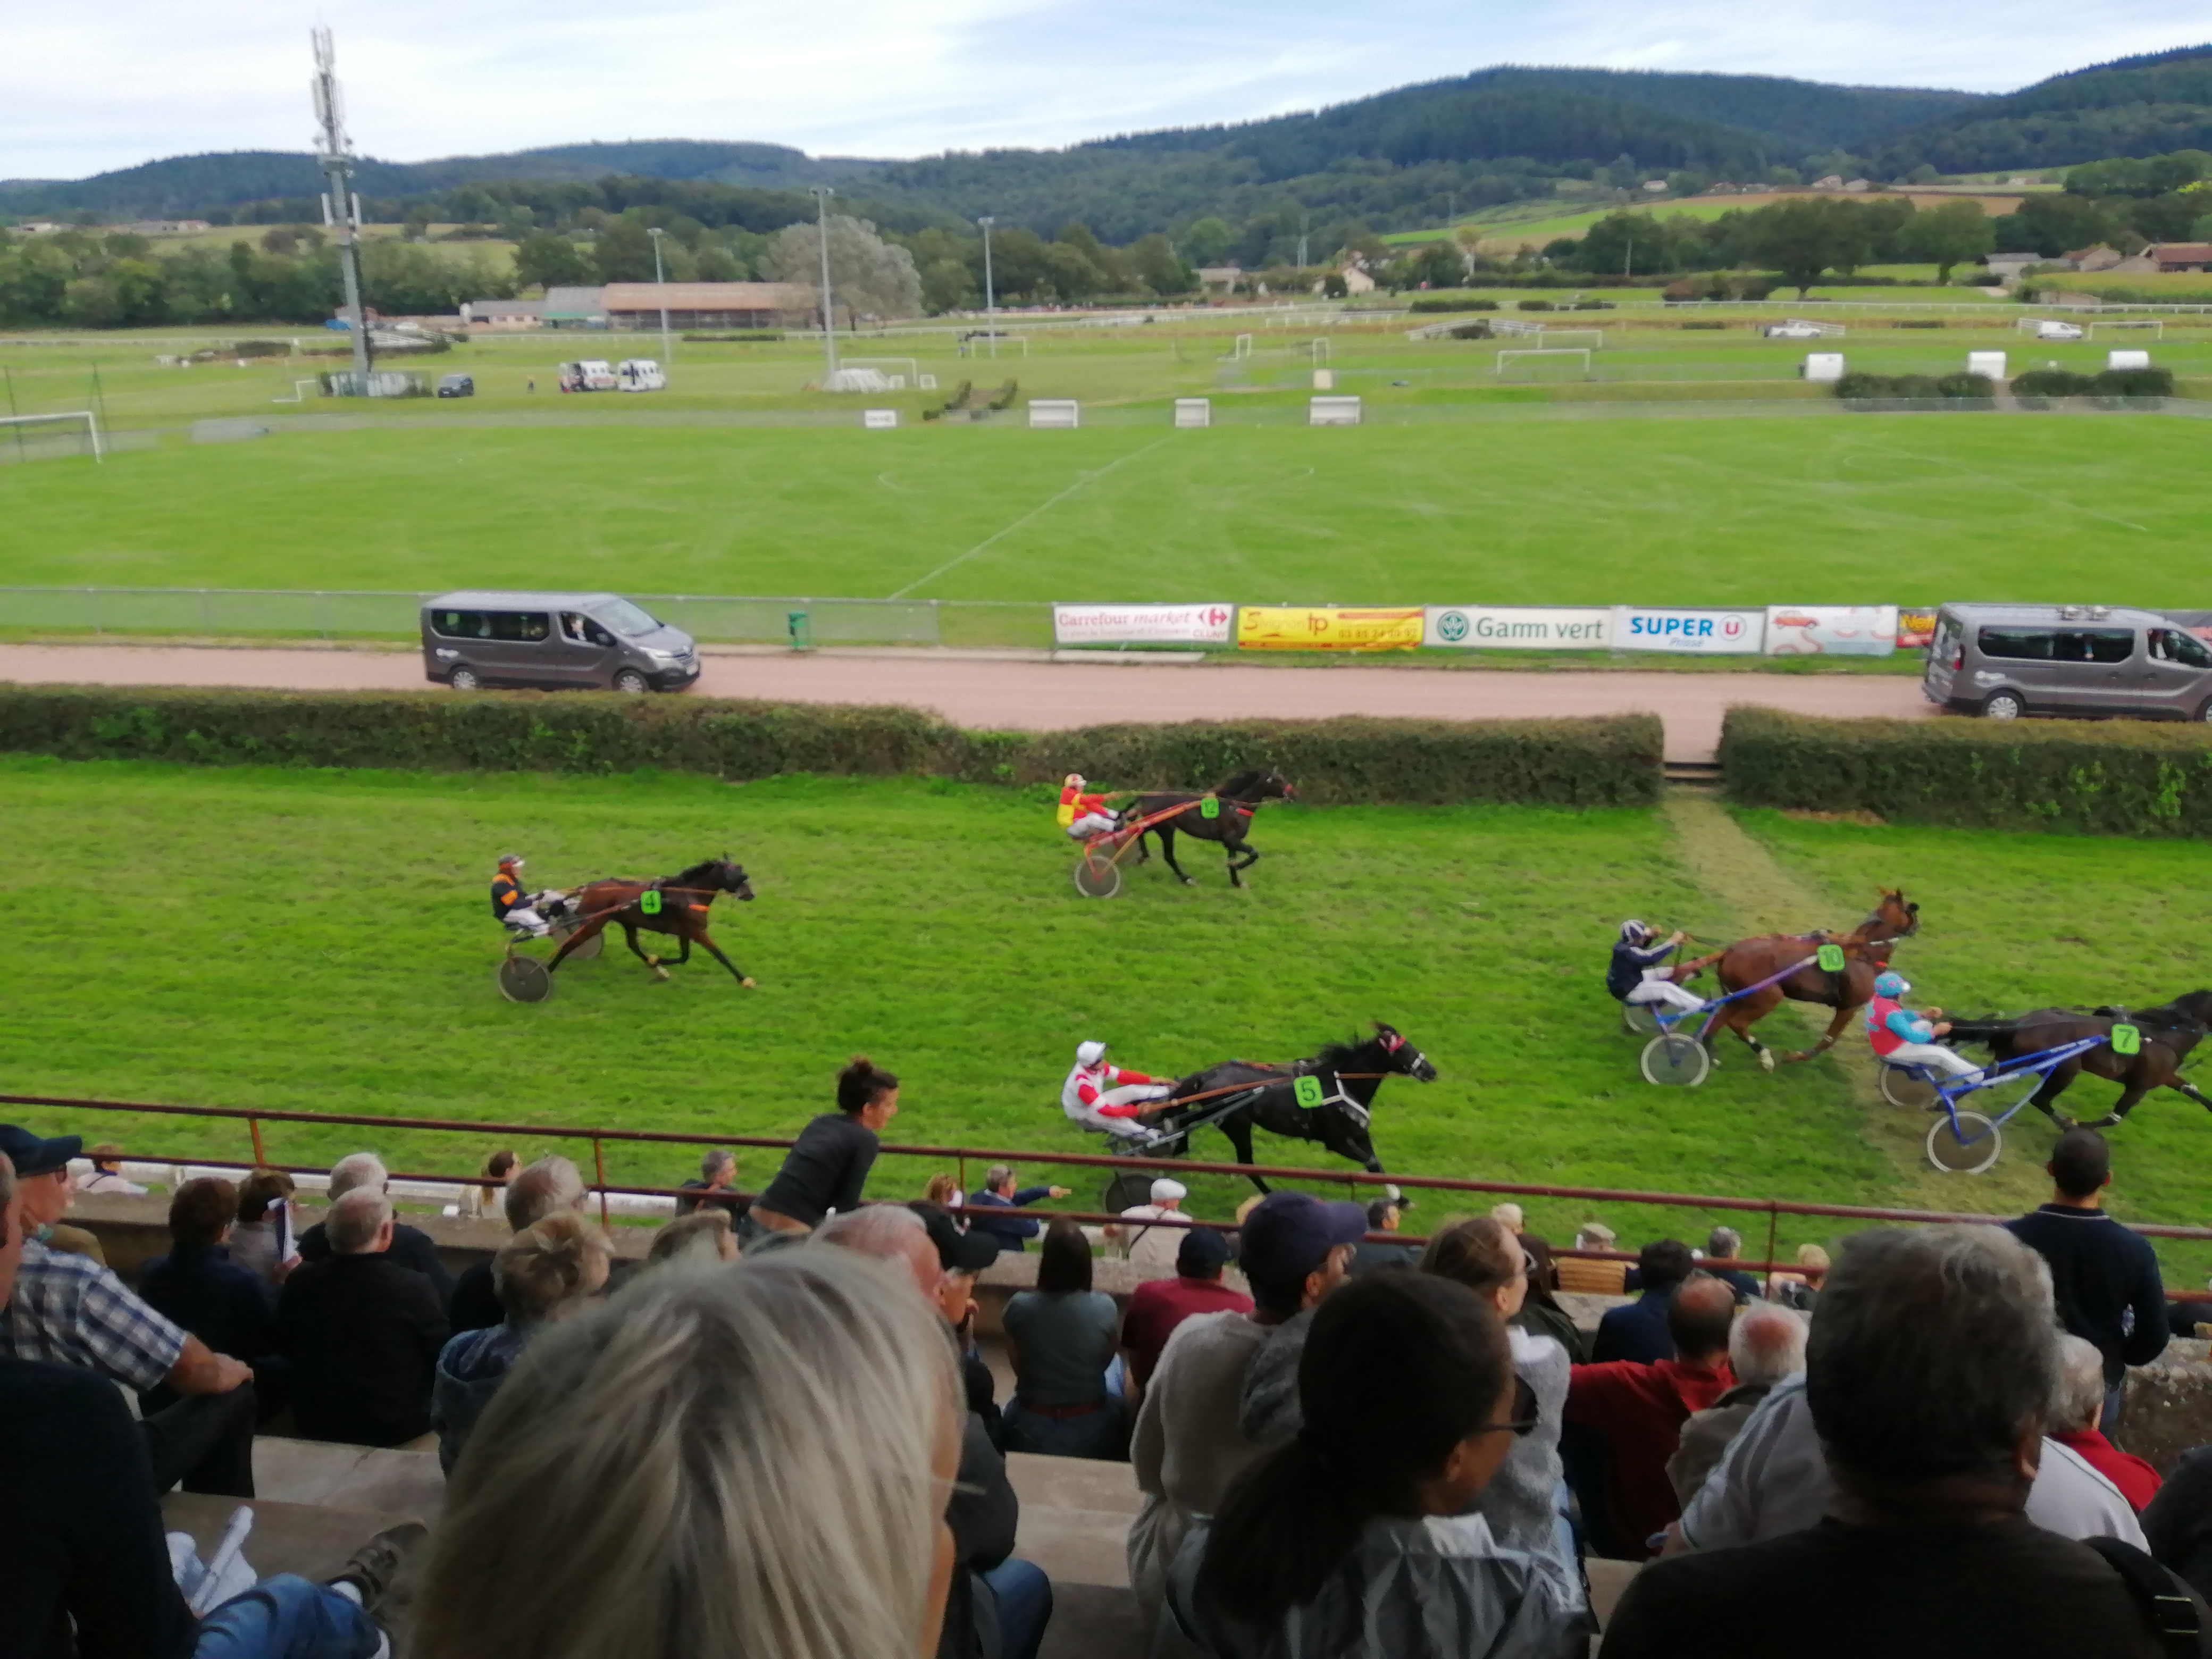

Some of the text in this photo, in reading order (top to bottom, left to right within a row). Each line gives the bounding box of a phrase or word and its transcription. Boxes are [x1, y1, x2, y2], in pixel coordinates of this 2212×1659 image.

[1058, 611, 1191, 627] Carrefour market
[1477, 616, 1603, 639] Gamm vert
[1630, 617, 1739, 636] SUPER U
[644, 893, 655, 909] 4
[1821, 949, 1841, 967] 10
[2118, 1028, 2134, 1049] 7
[1301, 1080, 1316, 1101] 5
